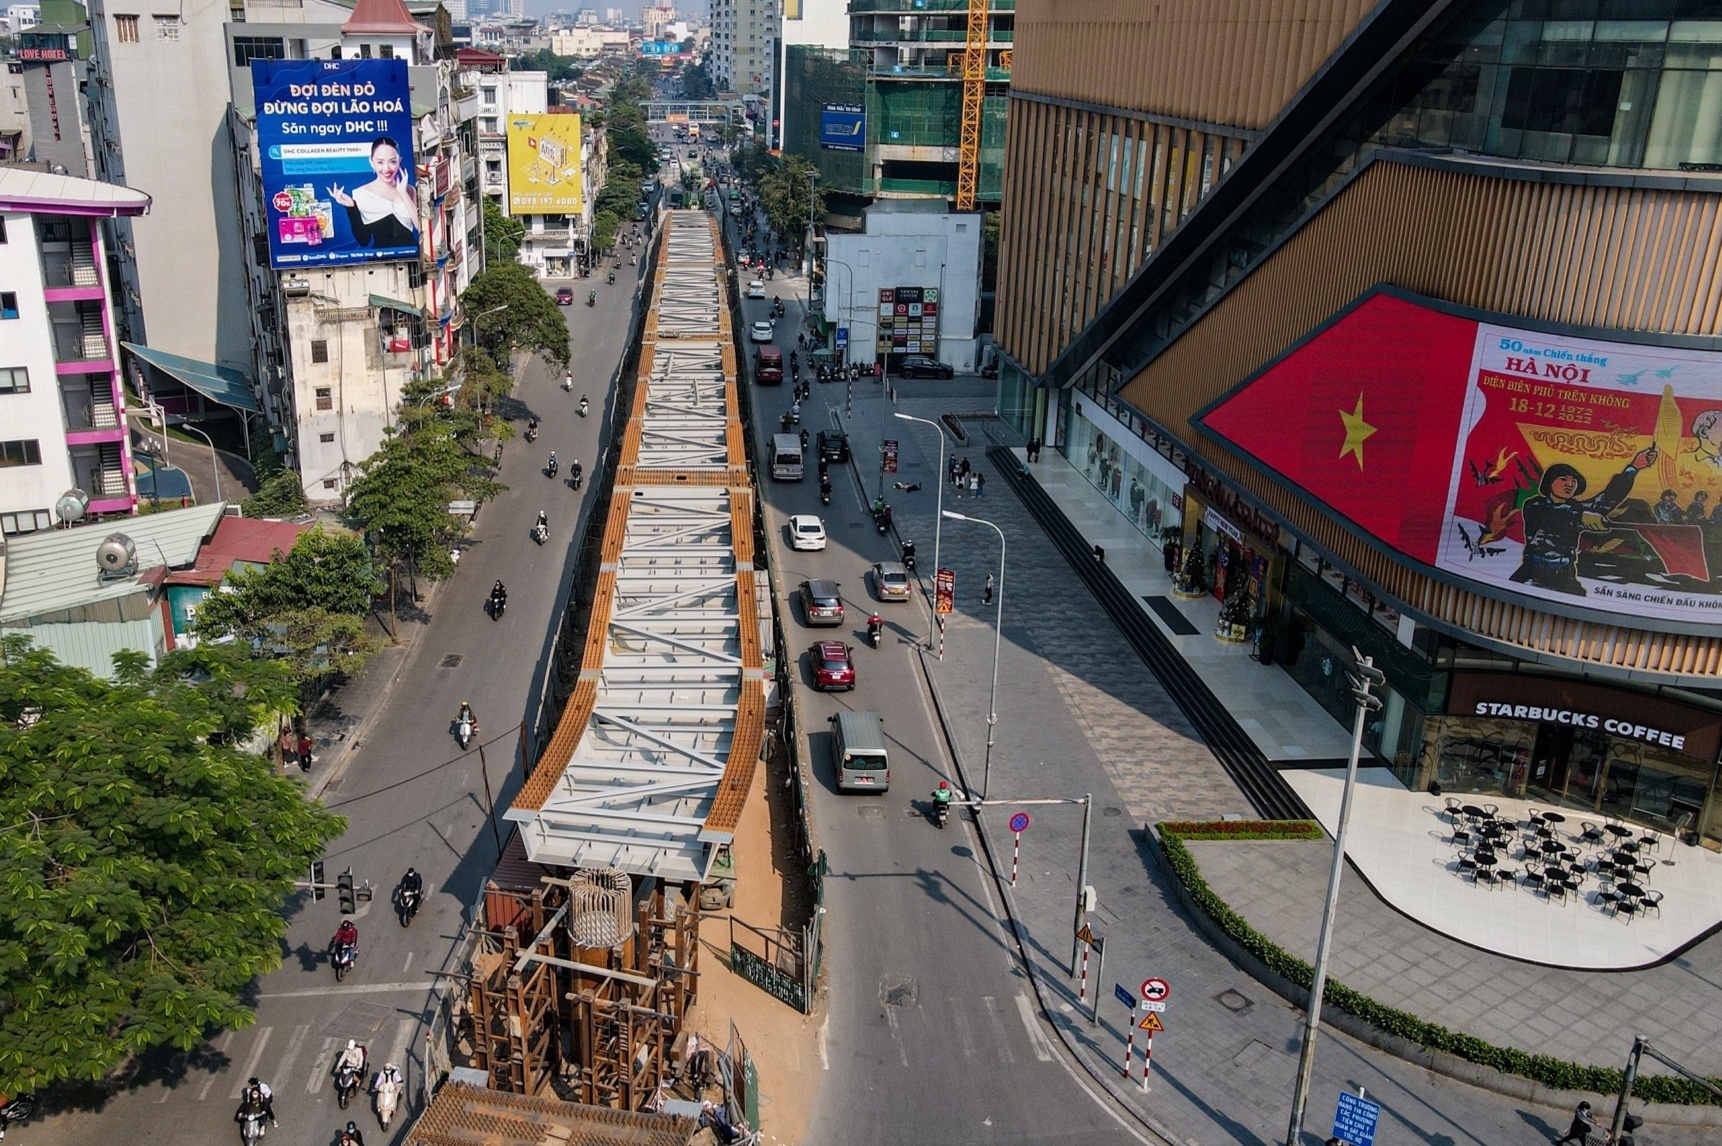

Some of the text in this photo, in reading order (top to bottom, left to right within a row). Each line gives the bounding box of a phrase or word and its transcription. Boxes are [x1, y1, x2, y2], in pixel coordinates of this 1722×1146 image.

[20, 49, 66, 59] LOVE HOTEL
[290, 80, 375, 100] ĐỢI ĐÈN ĐỎ
[264, 98, 404, 118] ĐỪNG ĐỢI LÃO HOÁ
[282, 122, 306, 134] Săn
[310, 124, 342, 136] ngay
[346, 121, 374, 133] DHC
[1500, 338, 1608, 367] 50 năm Chiến thắng
[1505, 356, 1591, 383] HÀ NỘI
[1483, 375, 1630, 408] ĐIỆN BIÊN PHỦ TRÊN KHÔNG
[1509, 397, 1556, 418] 18-12
[1560, 405, 1593, 416] 1972
[1558, 413, 1592, 424] 2022
[1616, 590, 1642, 600] SÀNG
[1644, 594, 1673, 604] CHIẾN
[1475, 702, 1685, 750] STARBUCKS COFFEE
